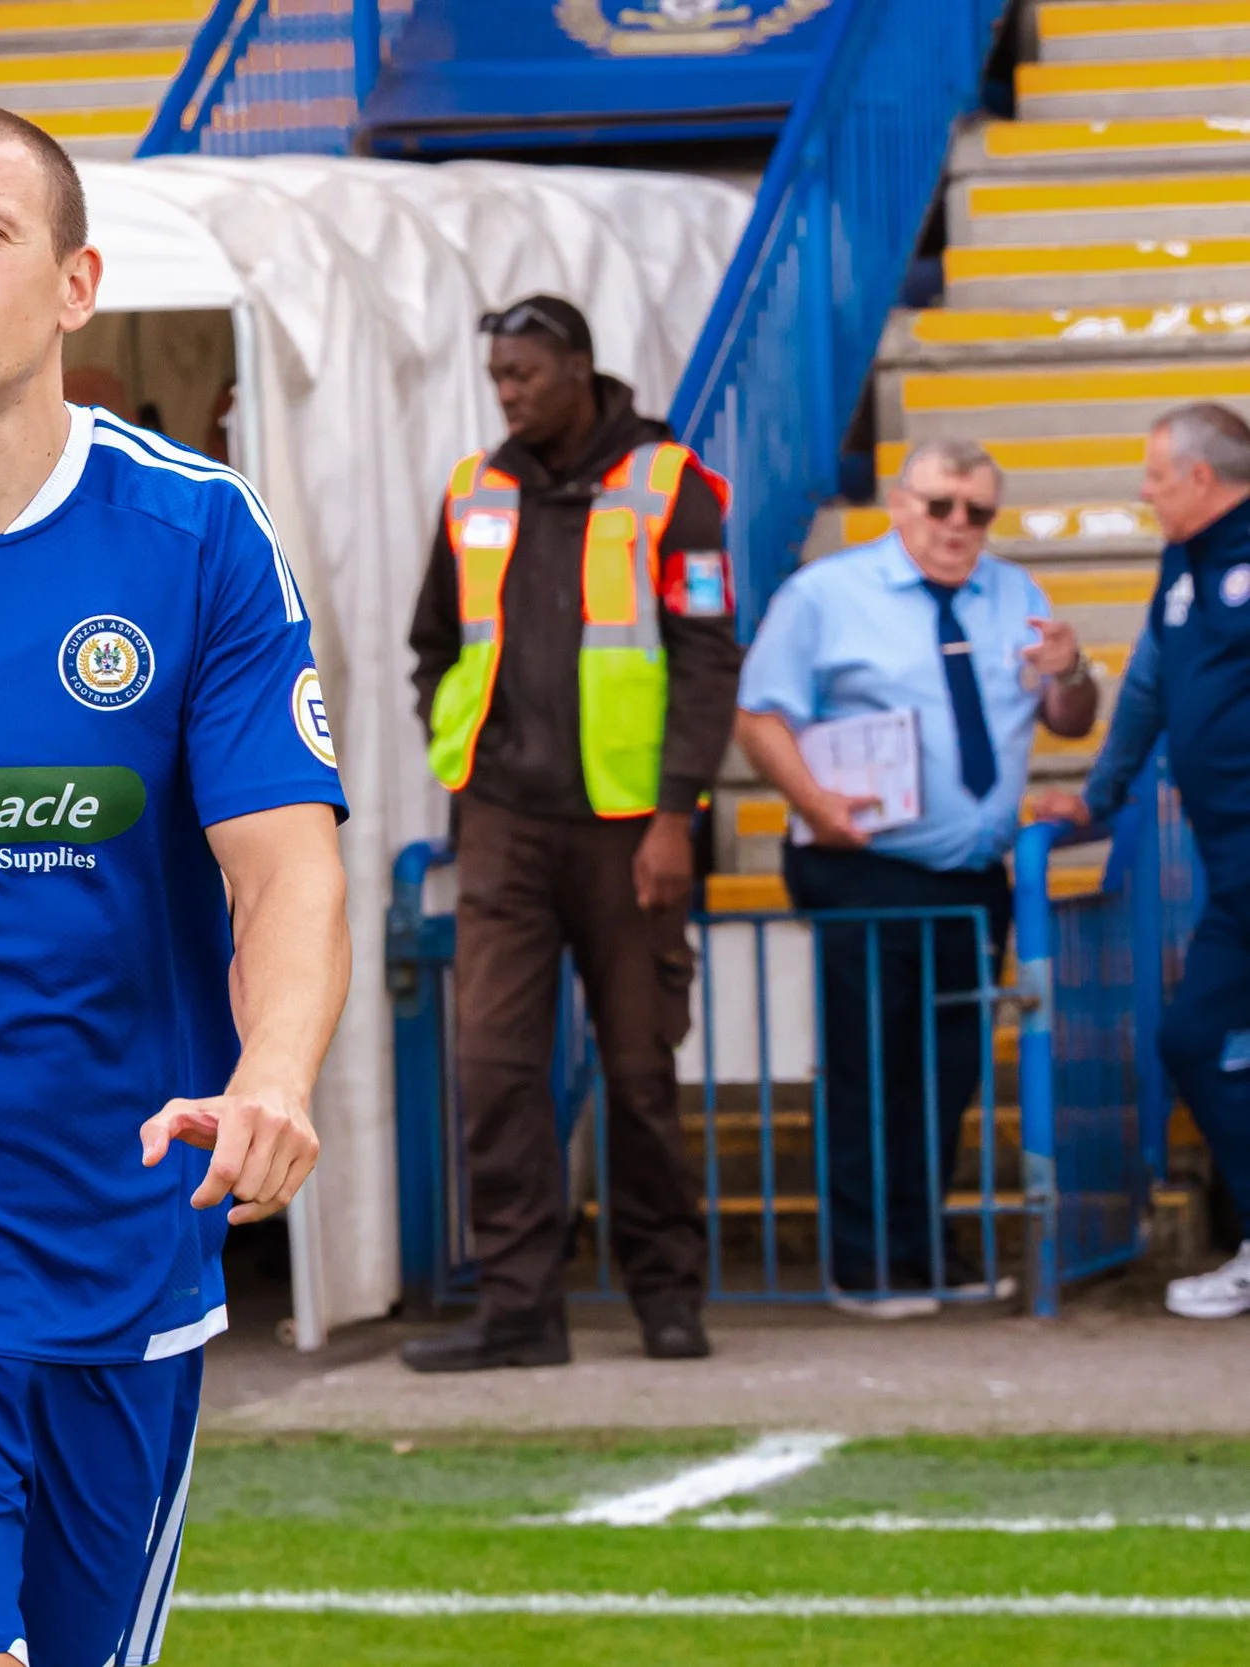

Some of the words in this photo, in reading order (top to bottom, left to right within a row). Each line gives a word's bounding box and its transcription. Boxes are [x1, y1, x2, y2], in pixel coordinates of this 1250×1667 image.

[68, 621, 105, 654] CURZON
[109, 621, 147, 654] ASHTON
[70, 675, 122, 703] FOOTBALL
[125, 674, 147, 698] CLUB
